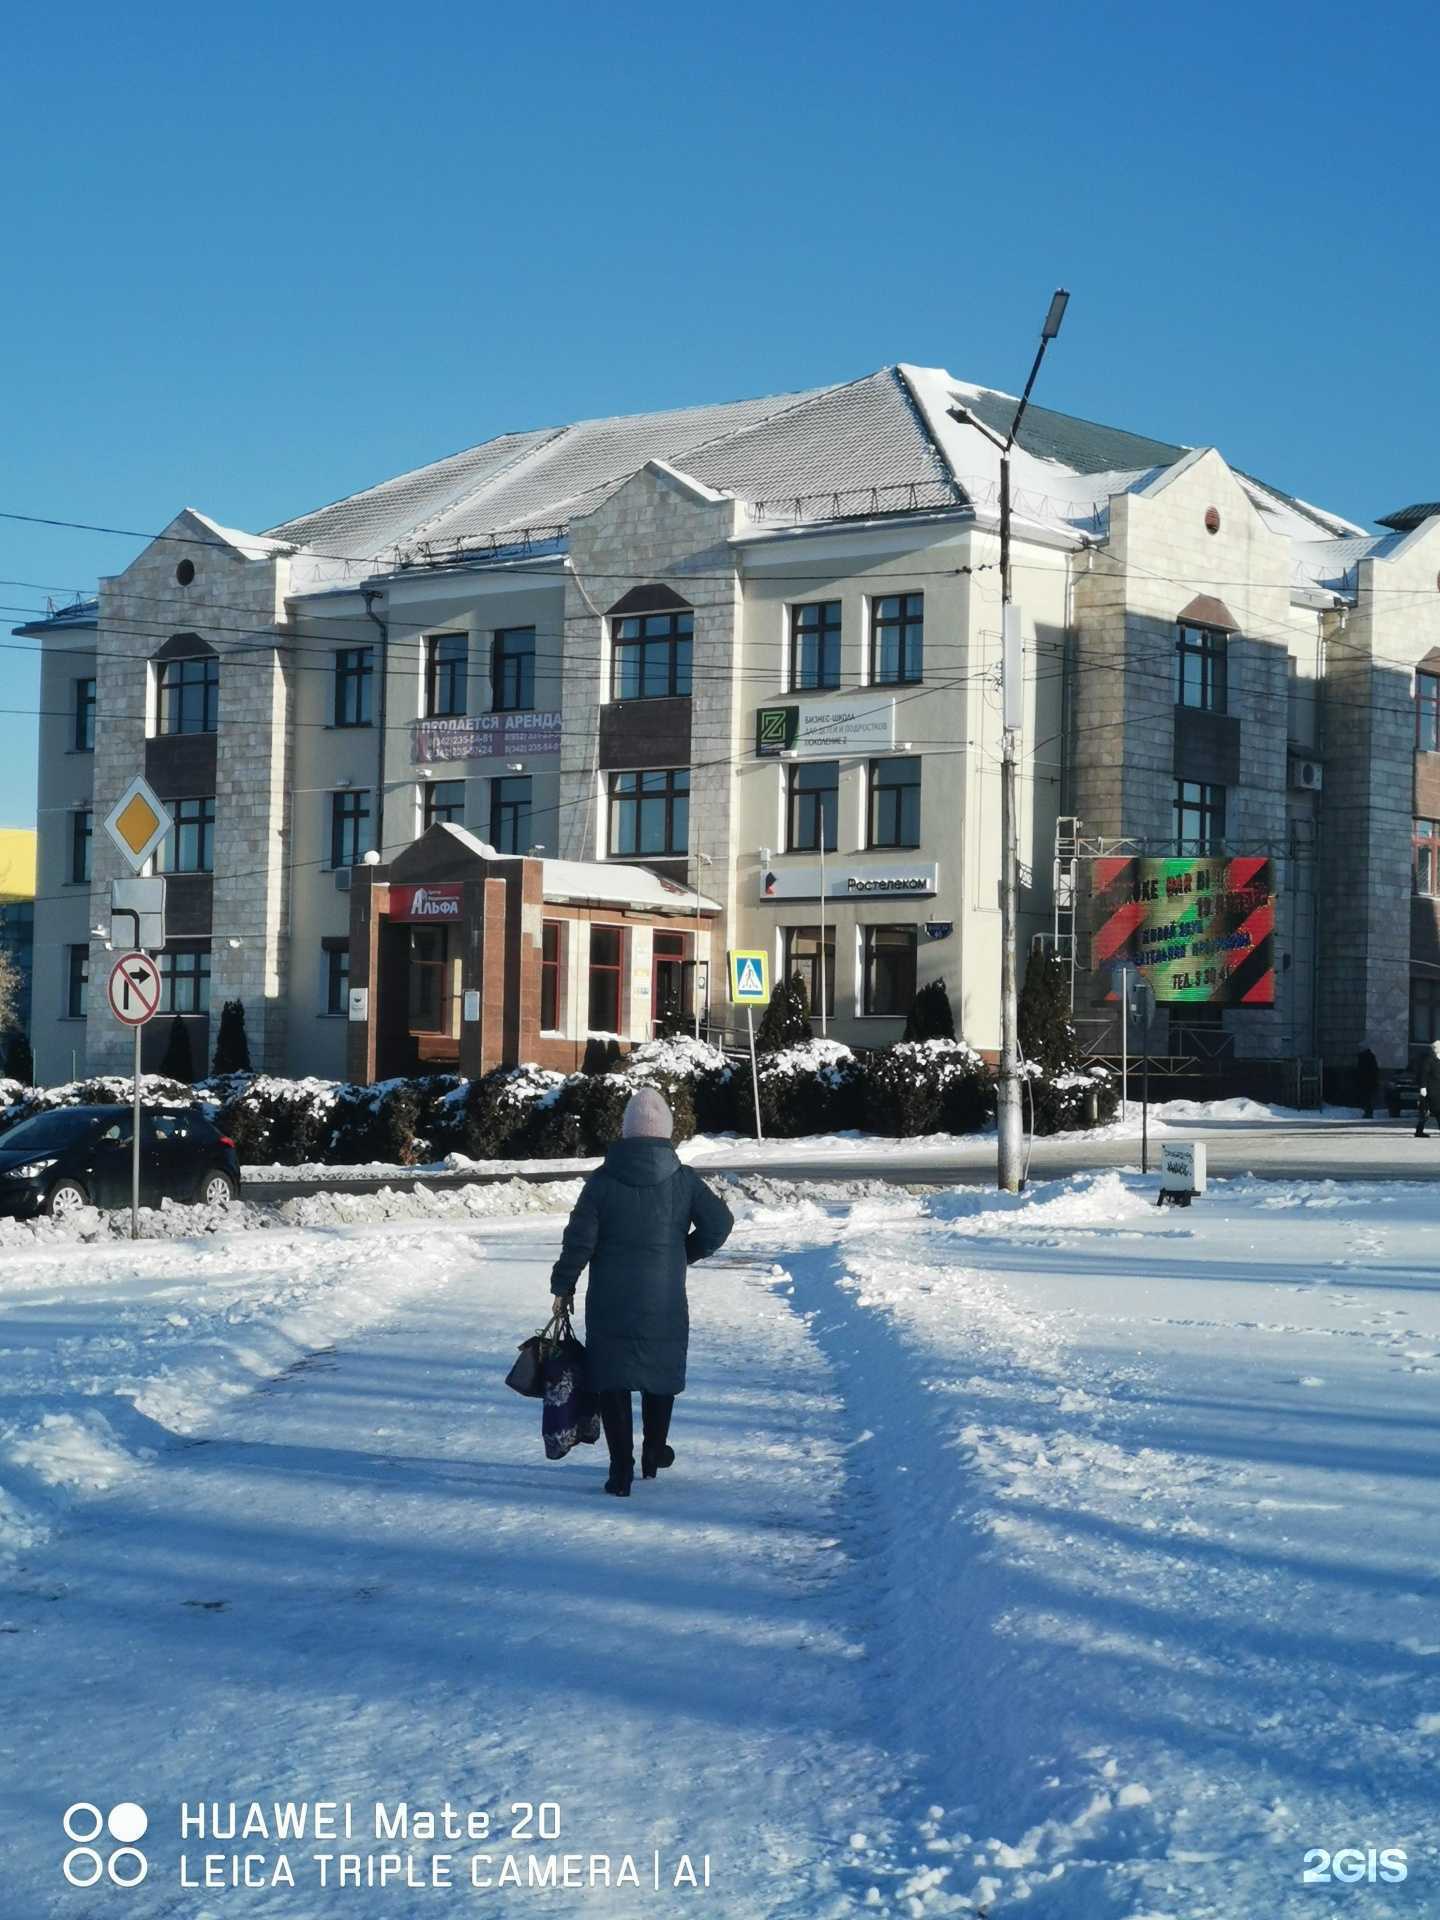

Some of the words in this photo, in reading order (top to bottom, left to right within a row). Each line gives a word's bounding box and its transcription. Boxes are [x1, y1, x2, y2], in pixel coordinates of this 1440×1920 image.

[421, 716, 499, 735] ПРОДАЕТСЯ
[505, 713, 561, 729] АРЕНДА
[847, 878, 927, 891] Ростелеком
